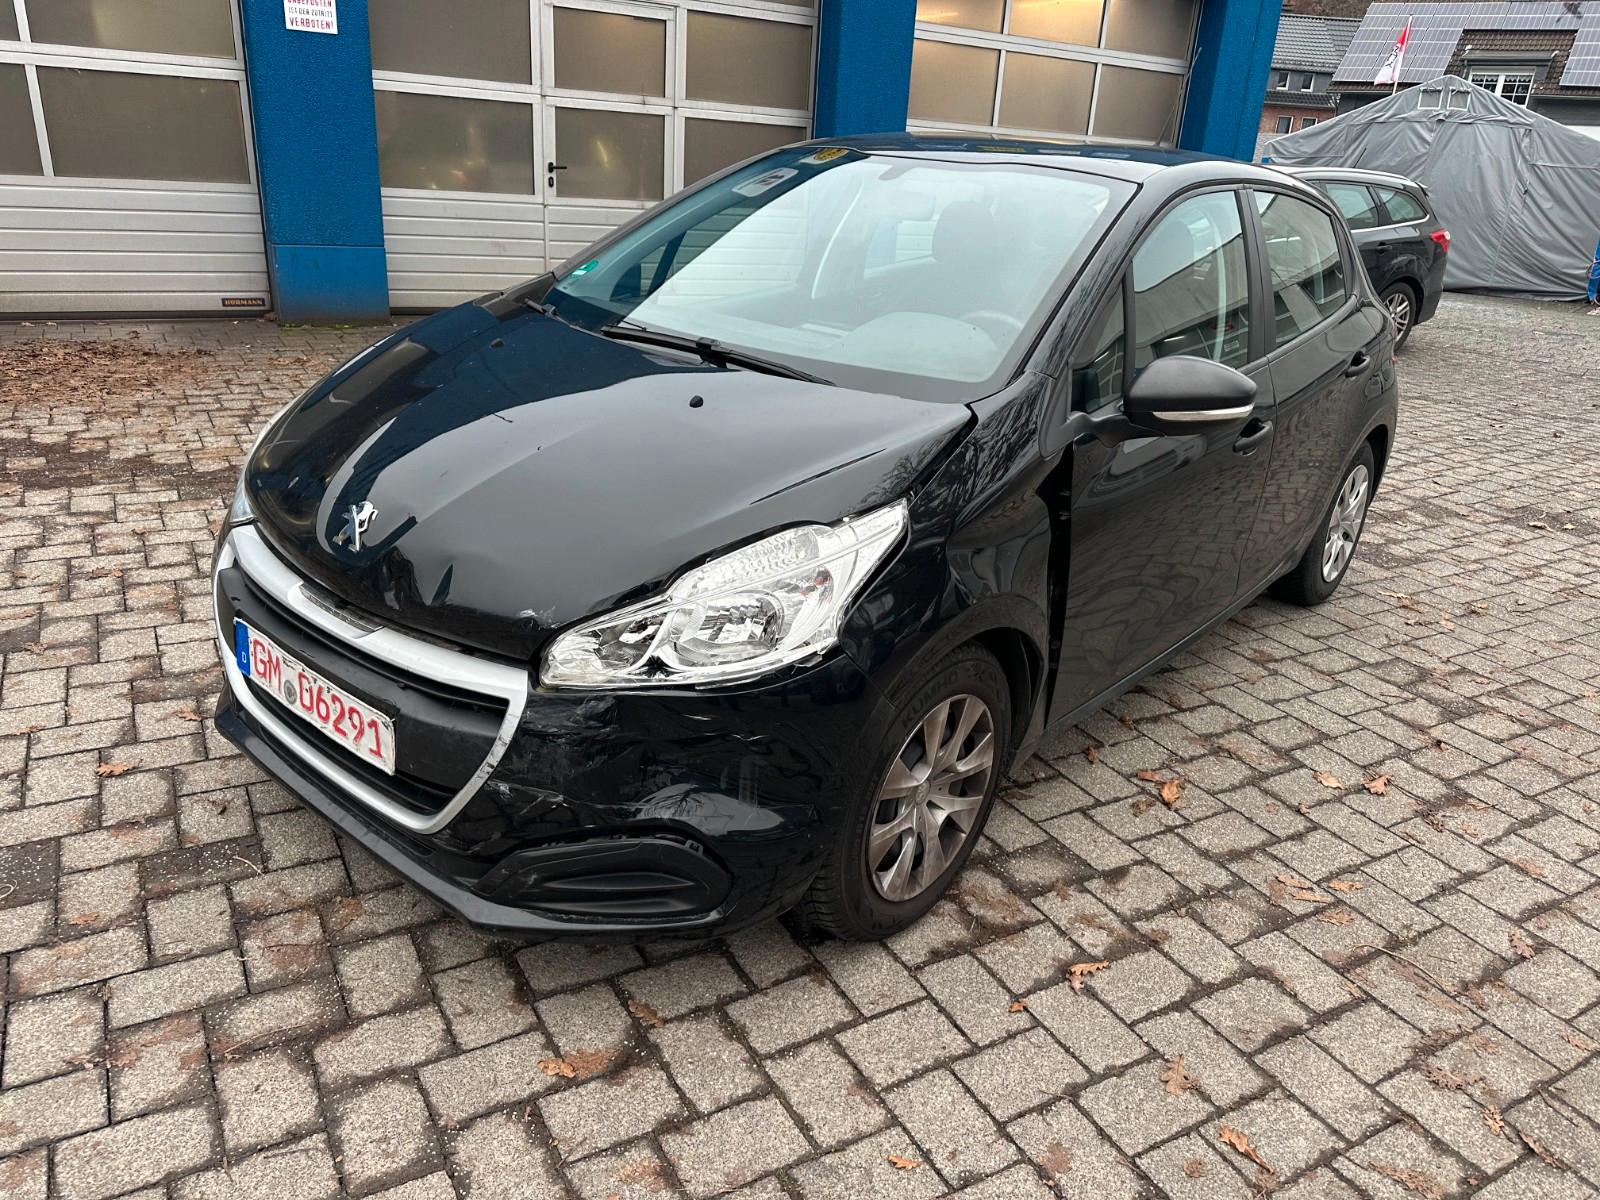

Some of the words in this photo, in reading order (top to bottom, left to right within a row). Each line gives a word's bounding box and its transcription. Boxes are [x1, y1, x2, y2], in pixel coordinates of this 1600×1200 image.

[290, 17, 334, 30] VERBOTEN!
[242, 651, 247, 663] D
[253, 638, 282, 694] GM
[298, 671, 383, 758] 06291
